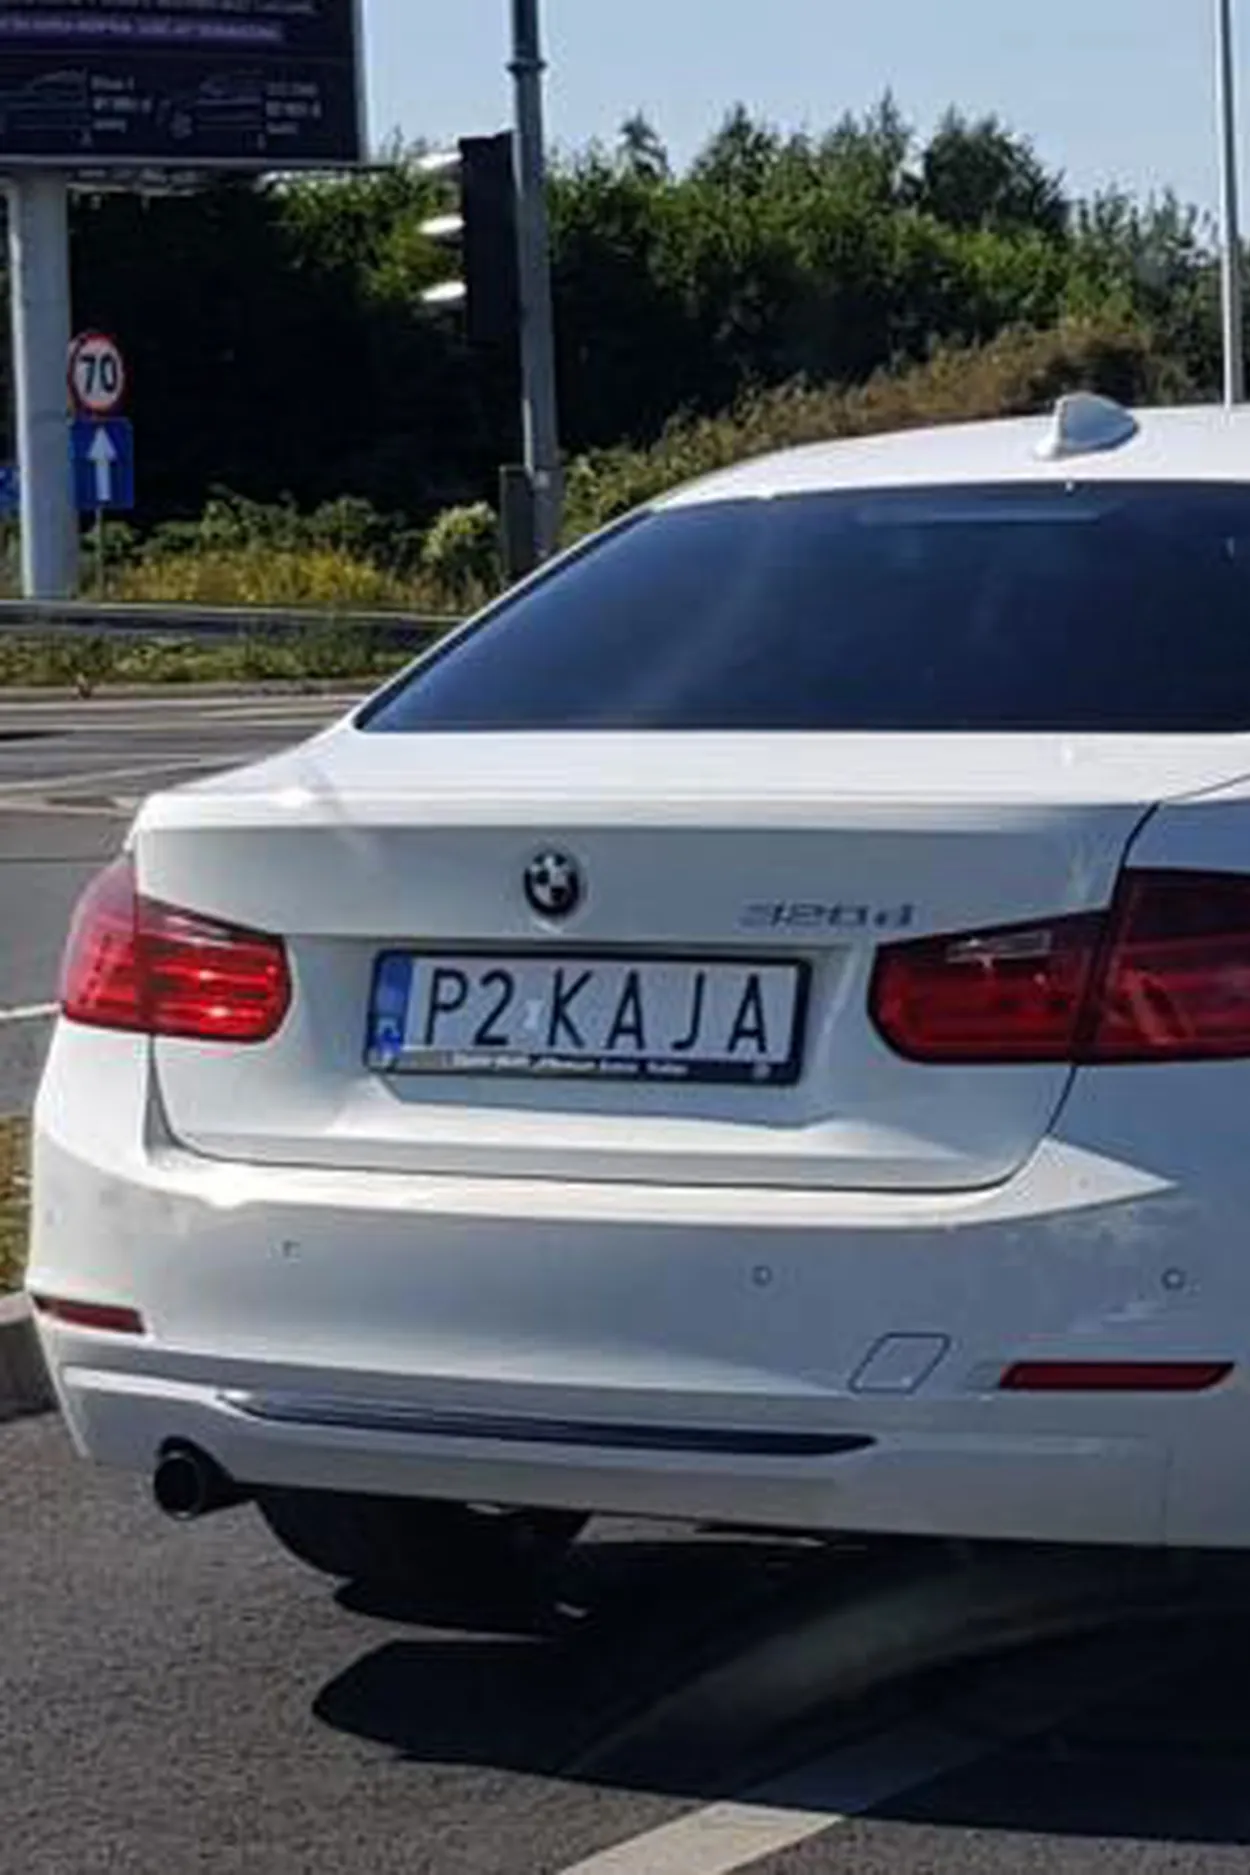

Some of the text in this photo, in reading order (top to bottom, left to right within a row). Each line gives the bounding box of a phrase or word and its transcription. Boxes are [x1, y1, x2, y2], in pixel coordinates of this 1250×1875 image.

[80, 353, 118, 393] 70
[425, 967, 769, 1054] P2 KAJA
